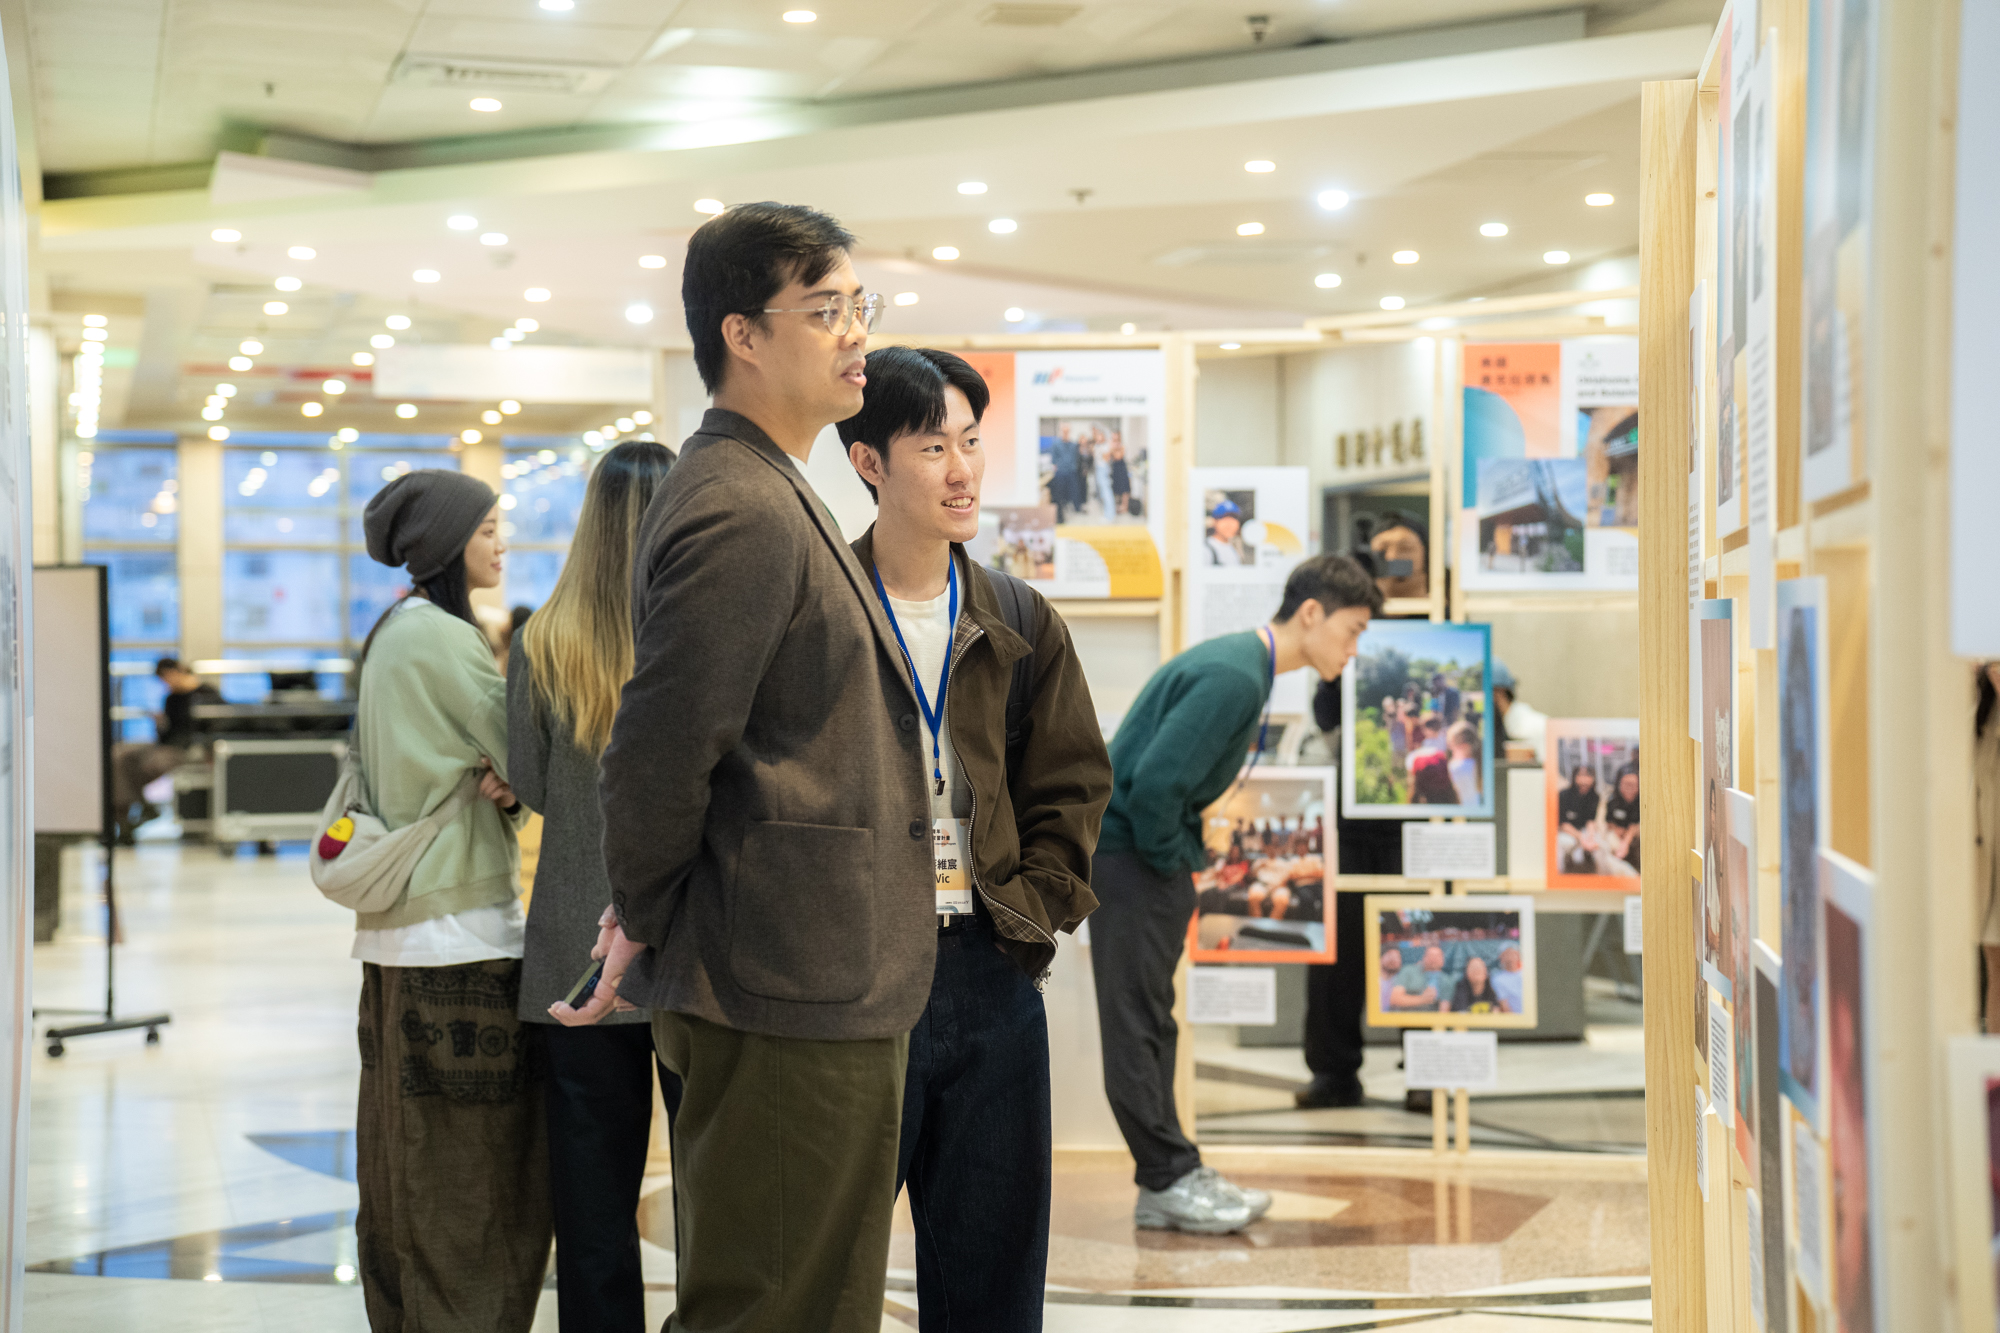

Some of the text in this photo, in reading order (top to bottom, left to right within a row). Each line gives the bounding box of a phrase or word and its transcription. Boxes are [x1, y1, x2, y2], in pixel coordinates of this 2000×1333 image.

[1051, 394, 1147, 405] Manpower Group
[936, 858, 957, 870] 維宸
[936, 873, 950, 884] Vic
